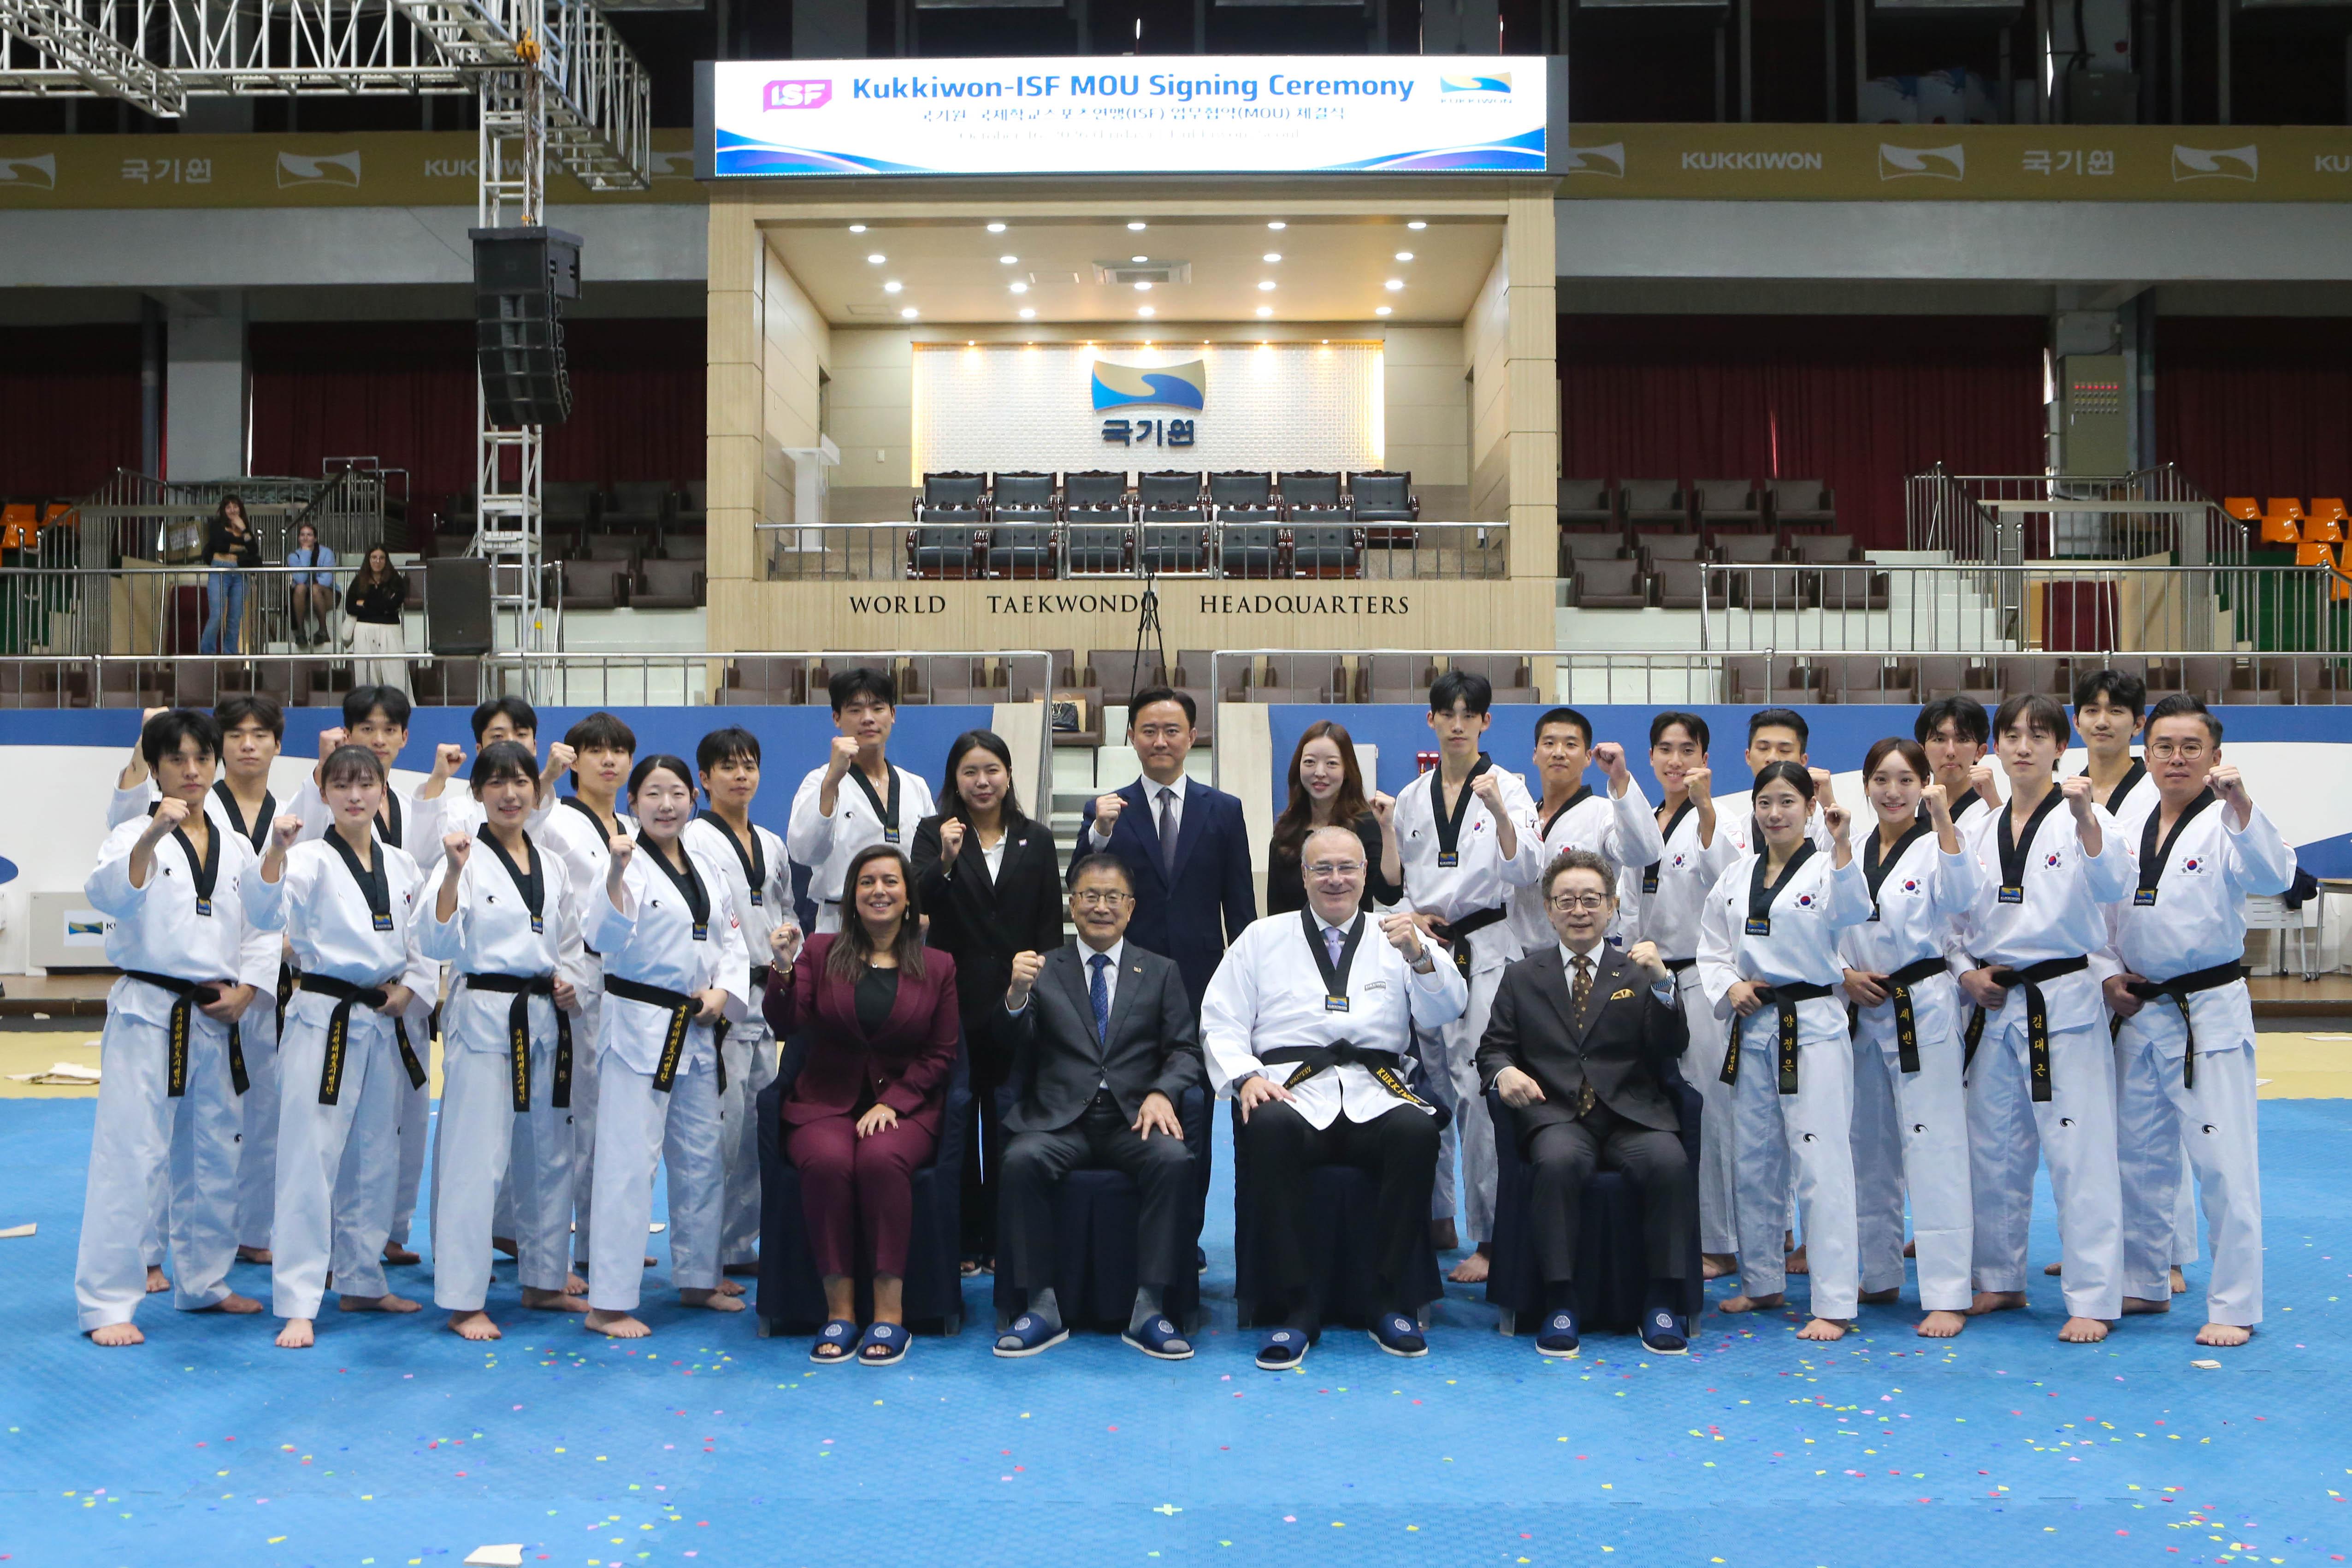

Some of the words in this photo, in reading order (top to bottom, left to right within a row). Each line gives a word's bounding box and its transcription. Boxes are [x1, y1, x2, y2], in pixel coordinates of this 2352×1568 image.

[772, 83, 826, 107] ISF
[853, 75, 1060, 99] Kukkiwon-ISF
[1071, 75, 1139, 96] MOU
[1150, 74, 1258, 102] Signing
[1269, 75, 1414, 102] Ceremony
[120, 158, 212, 183] 국기원
[1682, 152, 1822, 170] KUKKIWON
[2022, 150, 2114, 175] 국기원
[1101, 419, 1195, 447] 국기원
[850, 596, 946, 614] WORLD
[1200, 595, 1409, 615] HEADQUARTERS
